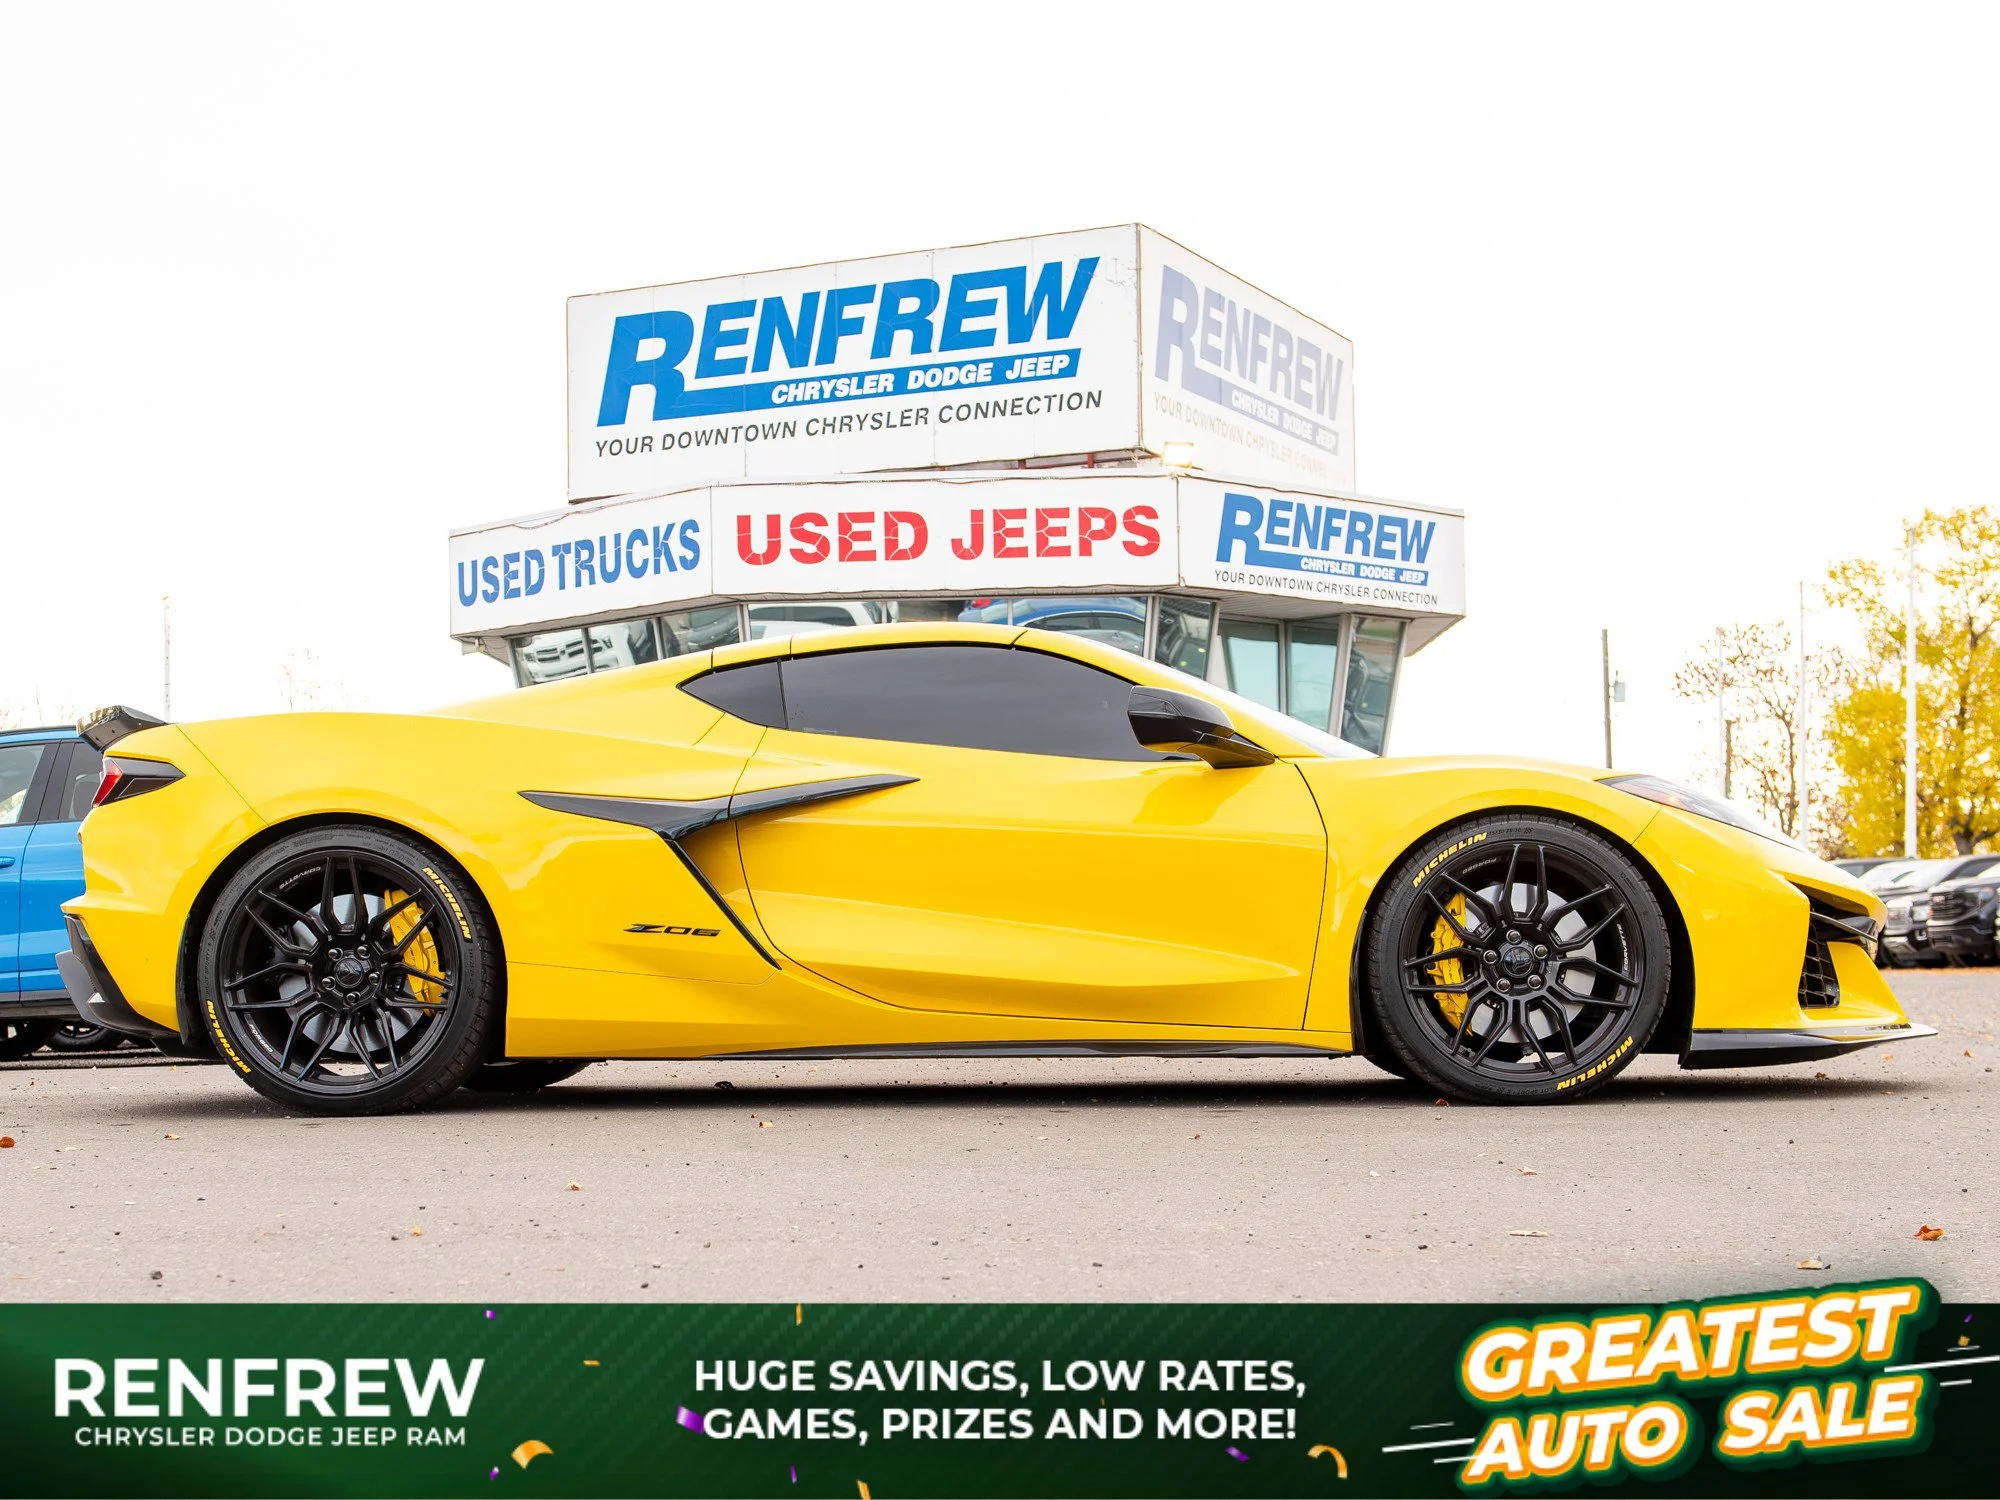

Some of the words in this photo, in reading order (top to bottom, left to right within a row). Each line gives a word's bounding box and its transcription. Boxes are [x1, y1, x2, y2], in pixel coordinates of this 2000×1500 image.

[597, 257, 1100, 426] RENFREW
[1155, 264, 1344, 421] RENFREW
[771, 372, 895, 404] CHRYSLER
[907, 362, 994, 390] DODGE
[1005, 354, 1071, 380] JEEP
[596, 435, 653, 457] YOUR
[662, 420, 798, 450] DOWNTOWN
[805, 407, 929, 436] CHRYSLER
[938, 390, 1102, 424] CONNECTION
[1154, 391, 1183, 422] YOUR
[1185, 405, 1244, 445] DOWNTOWN
[1231, 389, 1280, 426] CHRYSLER
[1283, 412, 1313, 440] DODGE
[1316, 427, 1338, 451] JEEP
[737, 512, 929, 566] USED
[951, 505, 1161, 561] JEEPS
[1216, 493, 1436, 564] RENFREW
[458, 550, 545, 607] USED
[551, 519, 701, 590] TRUCKS
[1214, 570, 1245, 585] YOUR
[1249, 575, 1314, 592] DOWNTOWN
[1316, 582, 1370, 598] CHRYSLER
[1373, 588, 1439, 606] CONNECTION
[1301, 557, 1355, 576] CHRYSLER
[1360, 564, 1395, 581] DODGE
[1400, 570, 1425, 584] JEEP
[279, 866, 322, 890] CORVETTE
[1412, 832, 1488, 888] MICHELIN
[422, 867, 472, 940] MICHELIN
[623, 923, 722, 937] Z06
[206, 1000, 252, 1074] MICHELIN
[1556, 1036, 1634, 1091] MICHELIN
